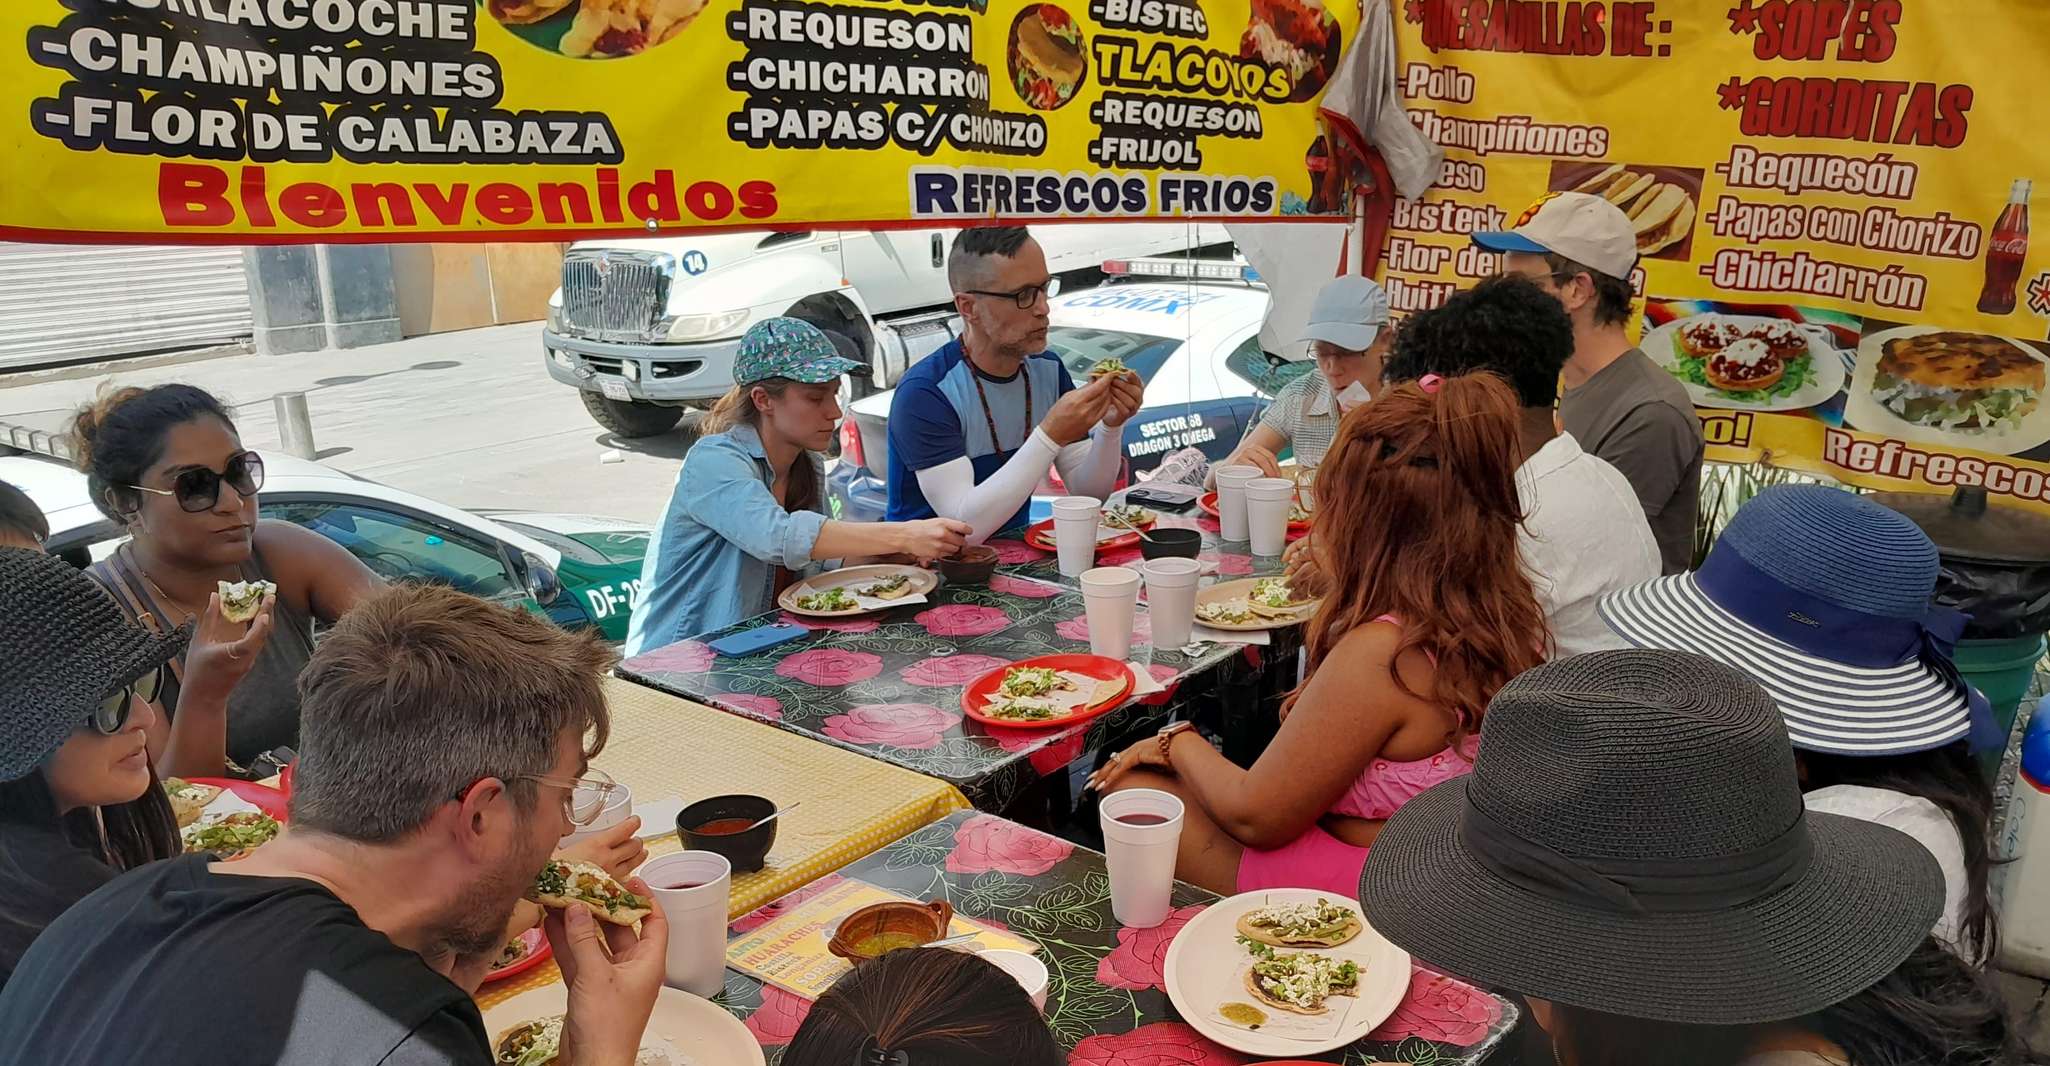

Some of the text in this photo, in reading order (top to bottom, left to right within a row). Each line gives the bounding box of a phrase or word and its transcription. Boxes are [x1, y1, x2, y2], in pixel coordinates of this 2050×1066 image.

[733, 7, 970, 53] -REQUESON
[1093, 0, 1207, 33] -BISTEC
[42, 27, 496, 98] -CHAMPIÑONES
[733, 58, 988, 101] -CHICHARRON
[1096, 43, 1290, 98] TLACOYOS
[45, 96, 616, 154] -FLOR DE CALABAZA
[734, 107, 885, 141] -PAPAS
[1094, 99, 1262, 133] -REQUESON
[1092, 137, 1199, 164] -FRIJOL
[1716, 144, 1917, 200] -Requesón
[914, 172, 1274, 214] REFRESCOS FRIOS
[1705, 195, 1982, 260] -Papas con Chorizo
[685, 253, 705, 272] 14
[1700, 249, 1928, 311] -Chicharrón
[1128, 438, 1172, 457] DRAGON
[1173, 435, 1181, 448] 3
[1140, 419, 1188, 438] SECTOR
[743, 921, 823, 967] HUARACHES
